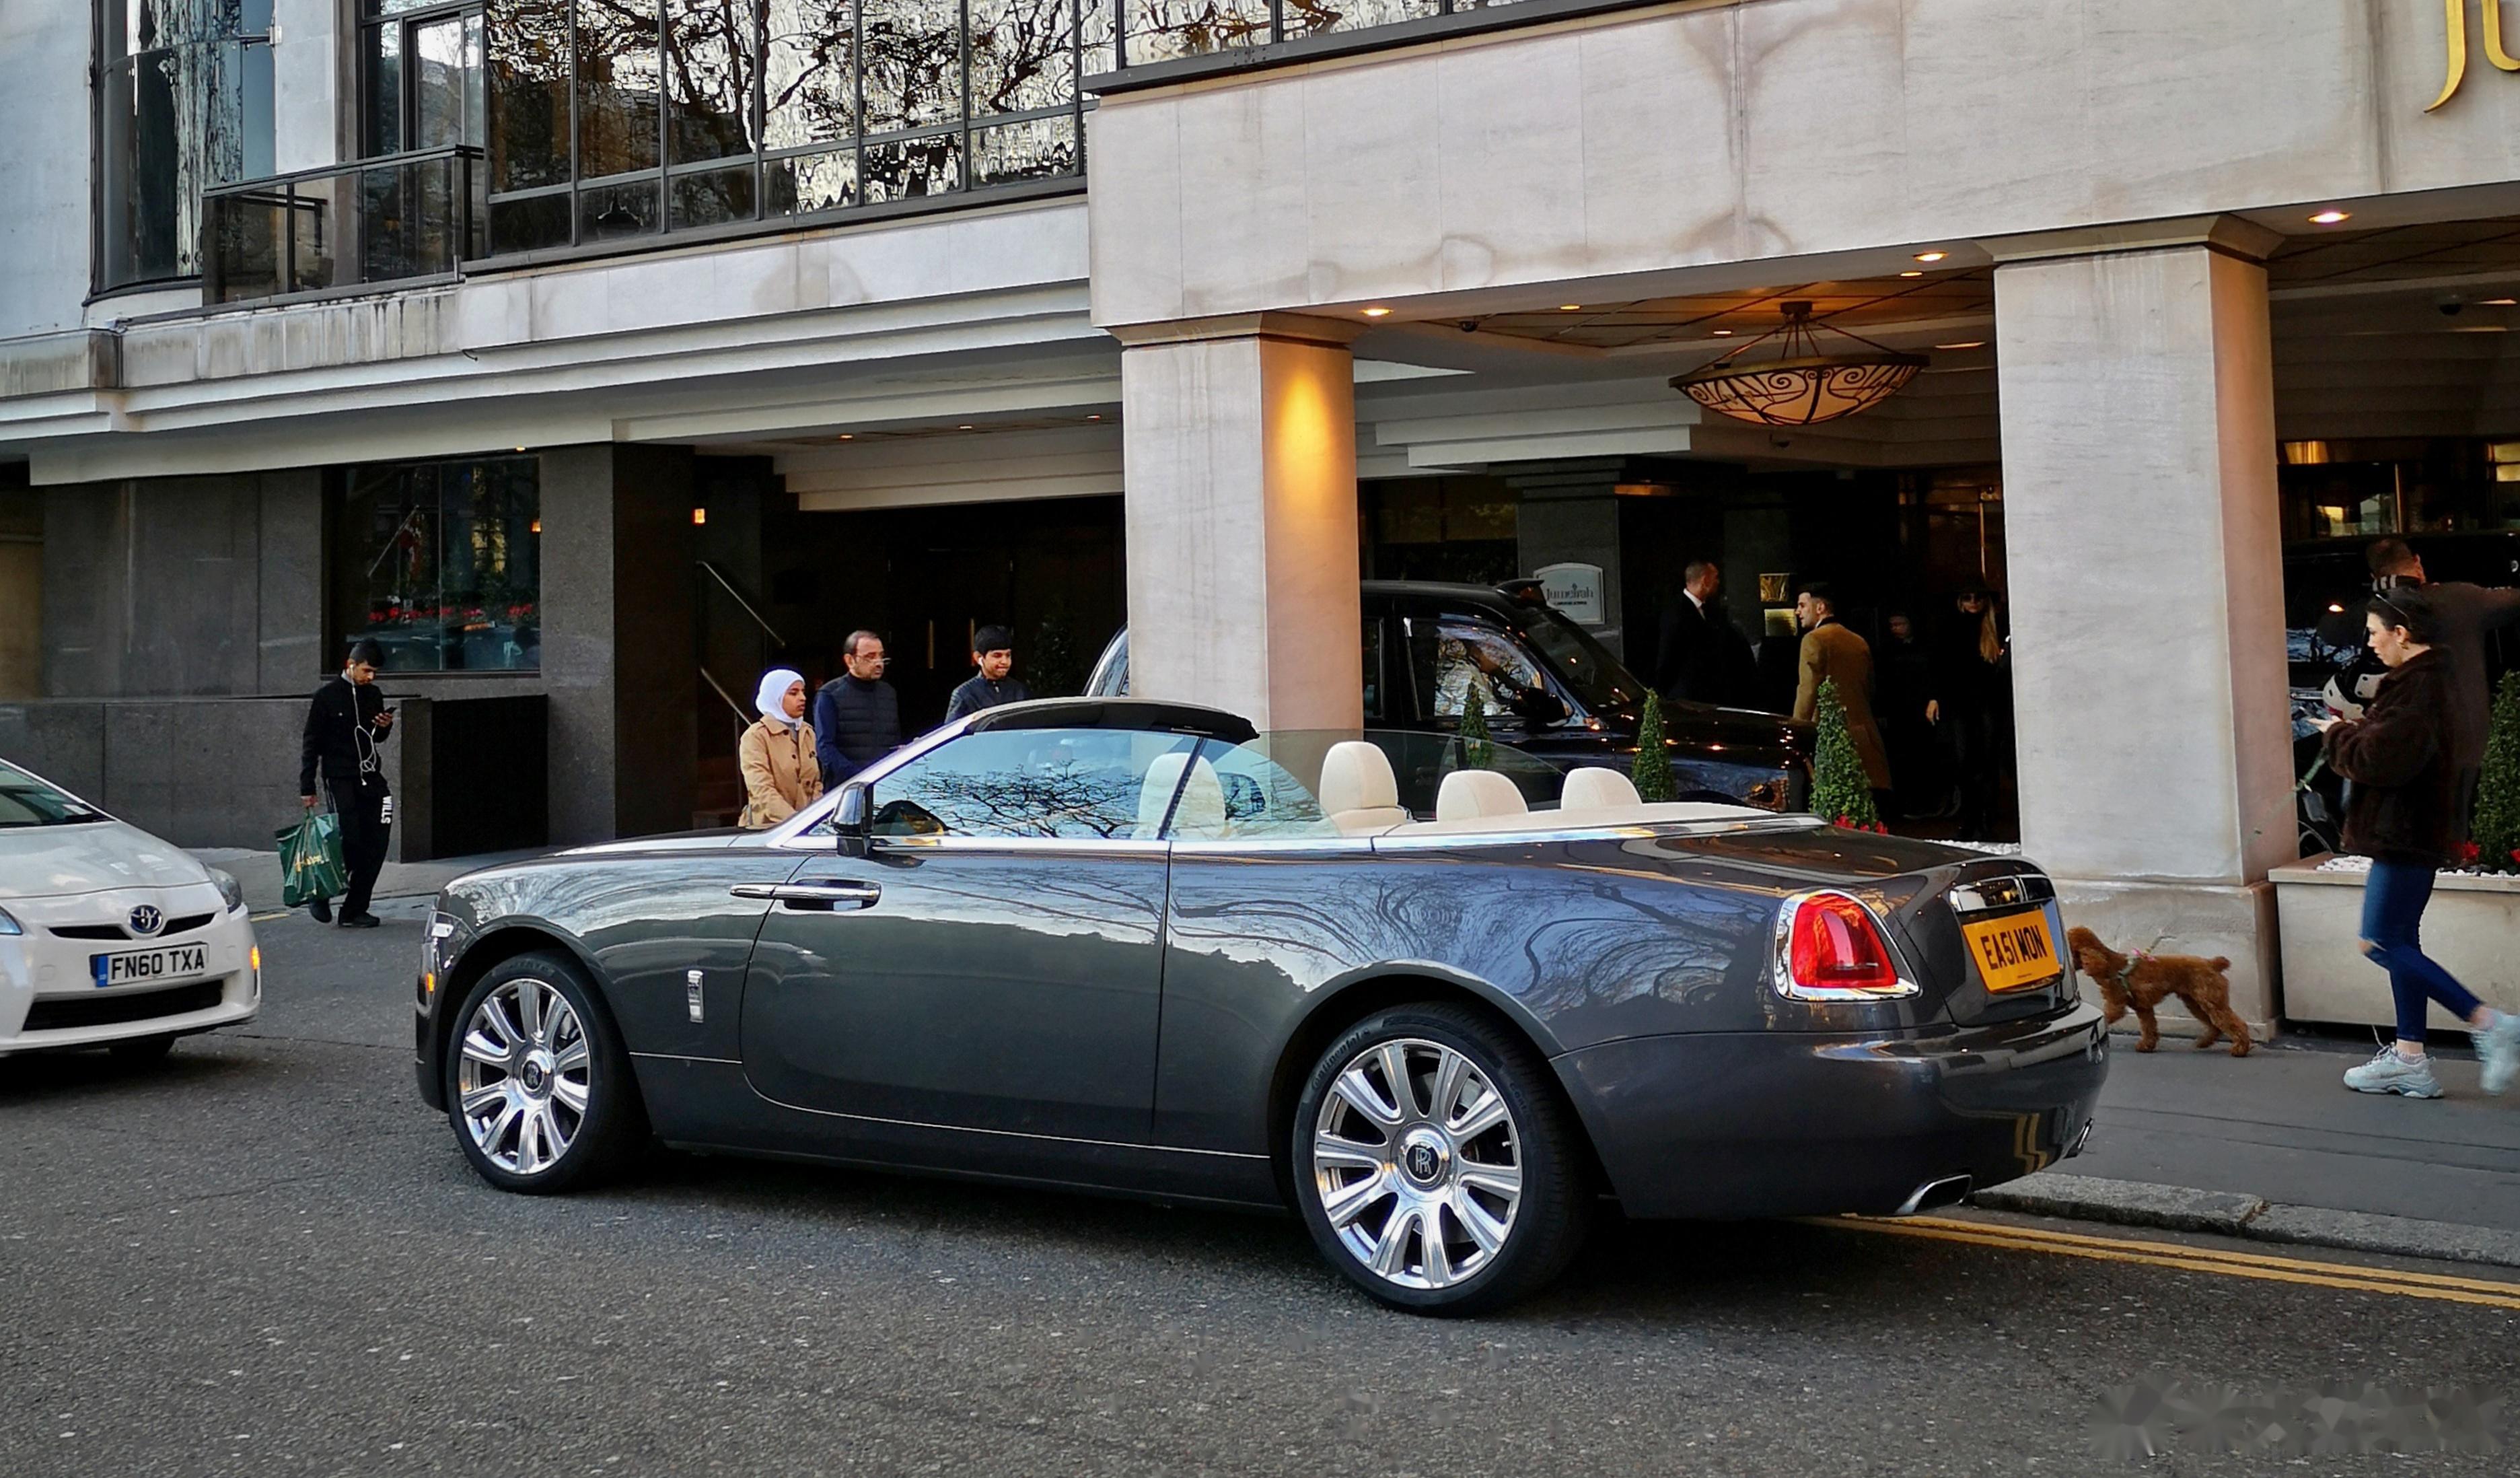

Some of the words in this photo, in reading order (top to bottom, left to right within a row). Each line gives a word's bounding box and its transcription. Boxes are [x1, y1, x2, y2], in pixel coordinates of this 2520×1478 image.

[381, 796, 392, 824] WILLS
[112, 954, 163, 980] FN60
[170, 948, 205, 973] TXA
[1980, 931, 2020, 971] EA51
[2013, 925, 2048, 962] MON
